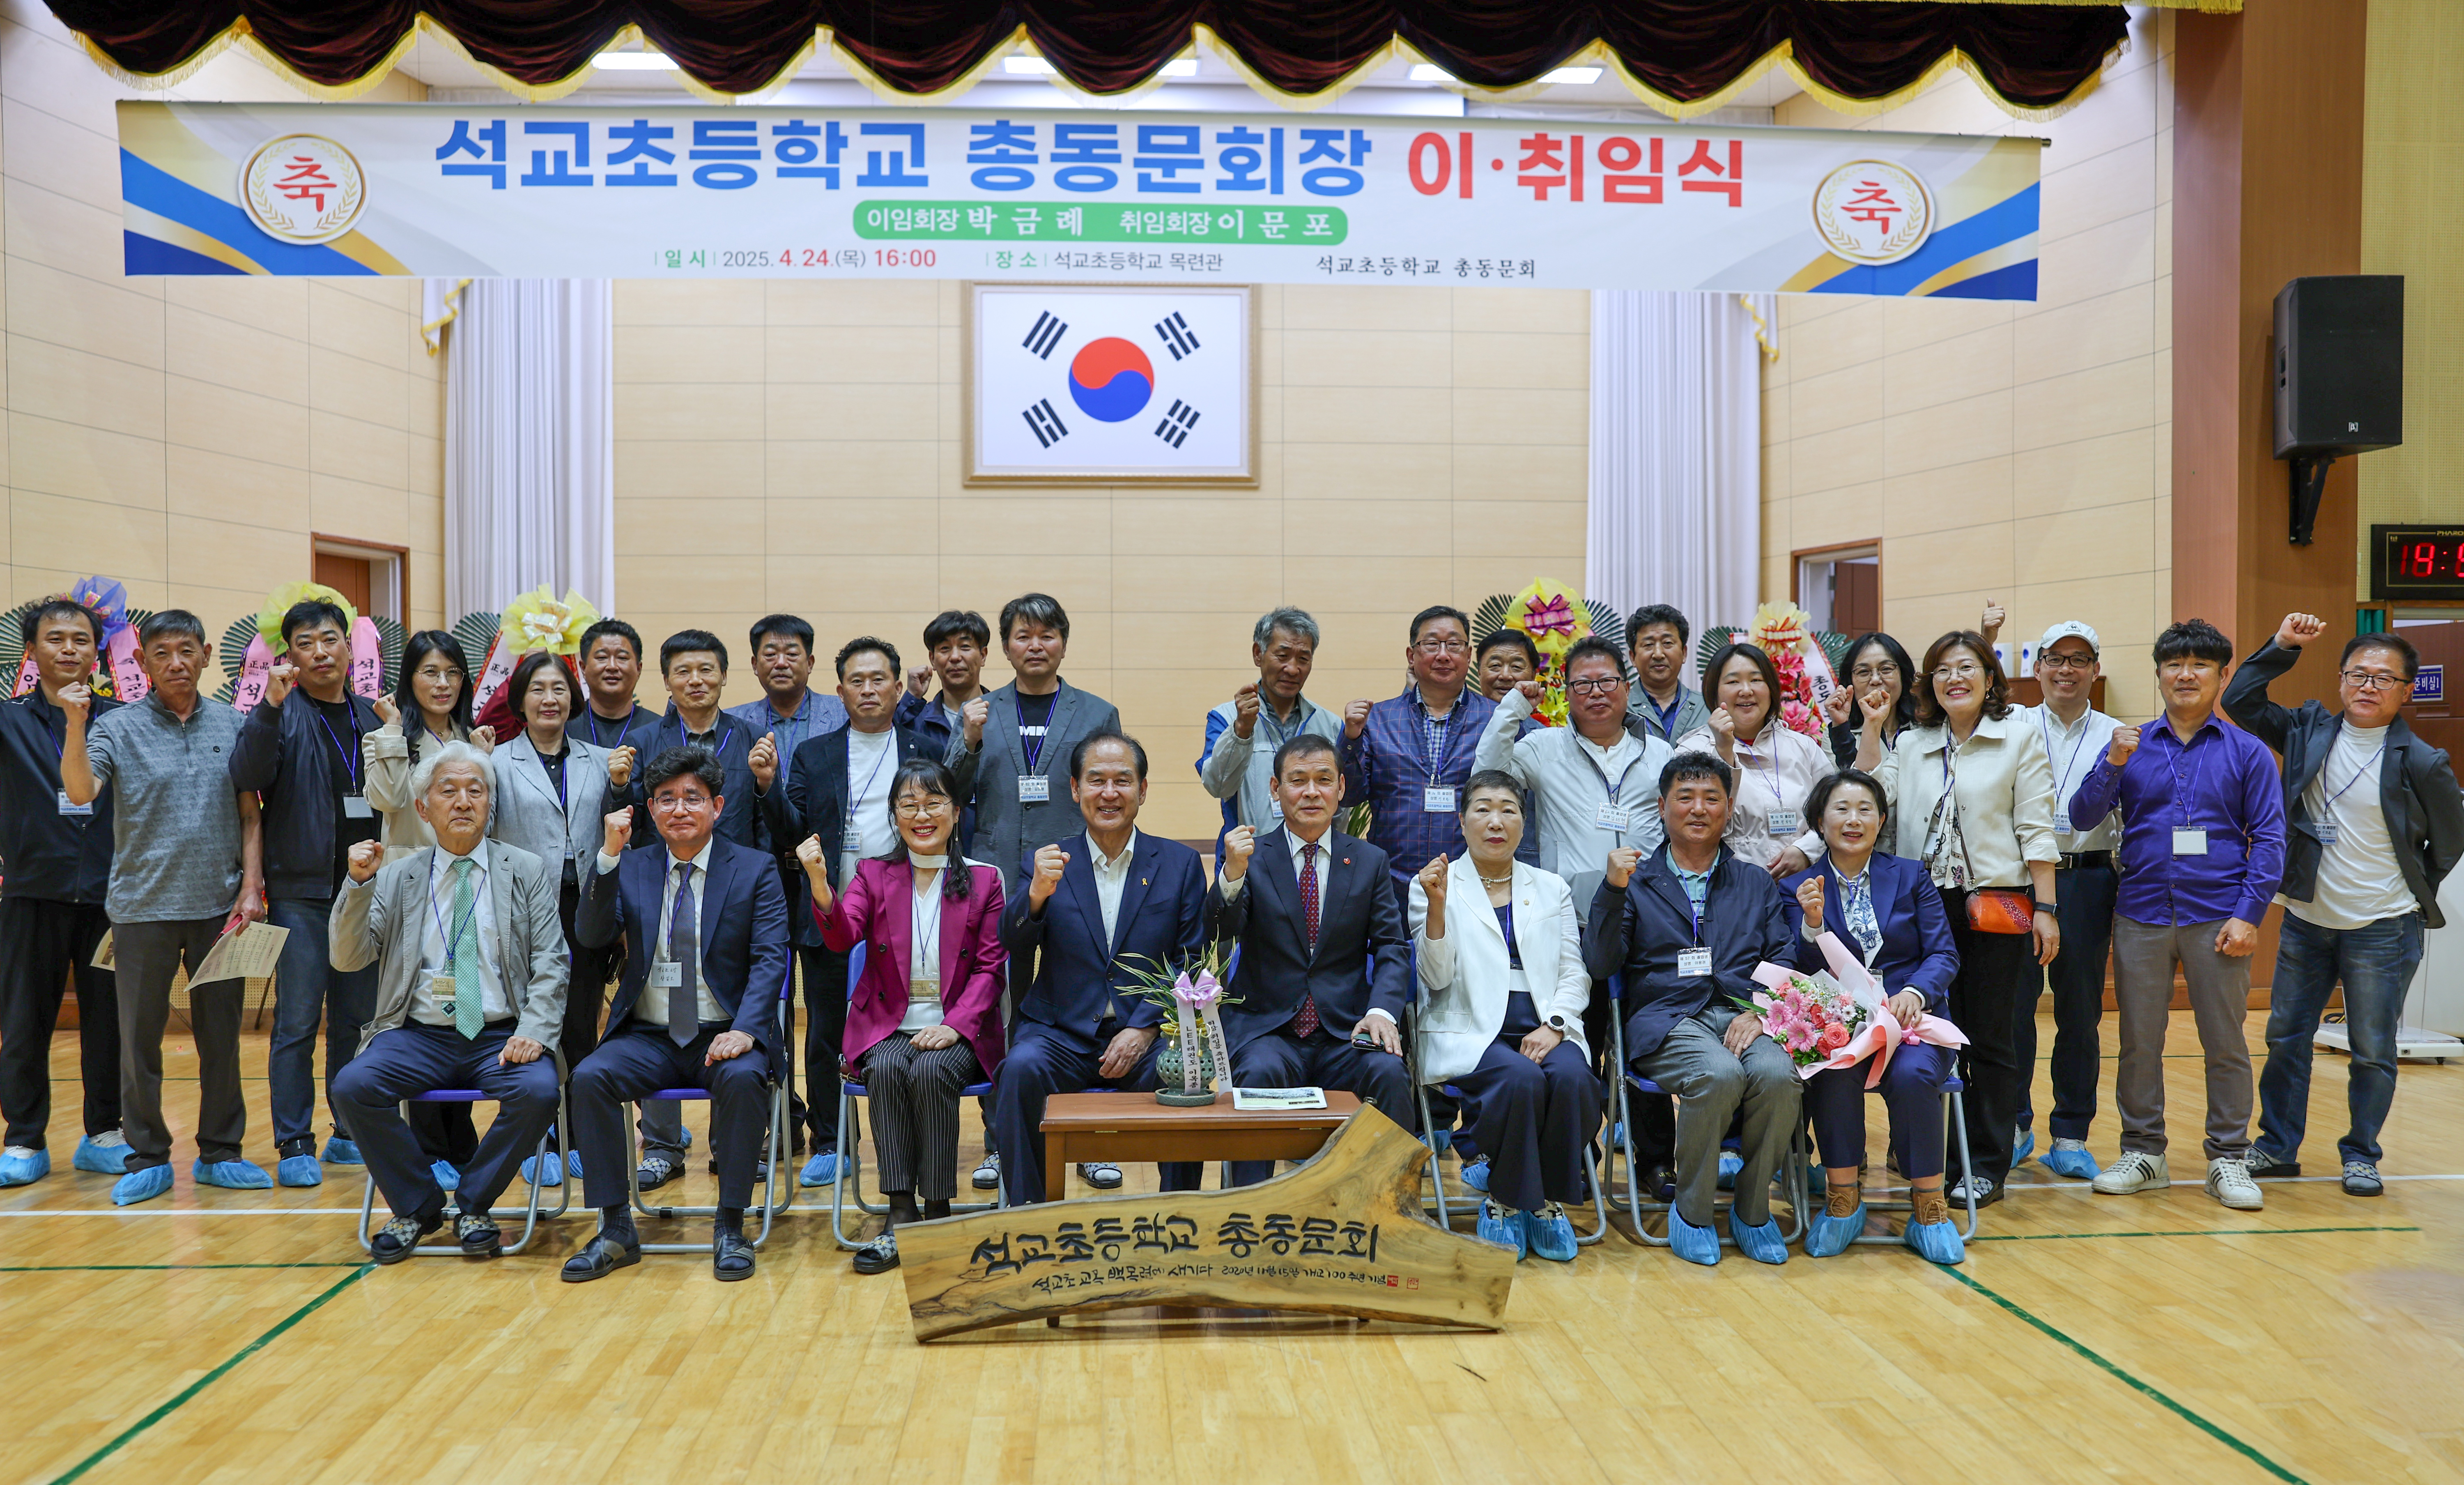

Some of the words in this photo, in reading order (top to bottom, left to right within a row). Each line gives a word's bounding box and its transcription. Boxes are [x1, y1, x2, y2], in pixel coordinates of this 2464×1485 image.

[436, 120, 929, 189] 석교초등학교
[966, 120, 1372, 196] 총동문회장
[1408, 131, 1742, 207] 이·취임식
[273, 156, 338, 212] 축
[867, 207, 960, 232] 이임회장
[1119, 210, 1213, 235] 취임회장
[1840, 181, 1902, 234] 축
[723, 251, 774, 267] 2025.
[874, 249, 936, 267] 16:00
[1054, 251, 1163, 271] 석교초등학교
[1169, 252, 1223, 271] 목련관
[1316, 255, 1441, 276] 석교초등학교
[1454, 257, 1535, 279] 총동문회
[490, 663, 509, 676] 正品
[2414, 676, 2439, 692] 준비실1
[1216, 1051, 1229, 1081] 축하드립니다
[970, 1213, 1199, 1276] 석교초등학교
[1218, 1212, 1379, 1263] 총동문회
